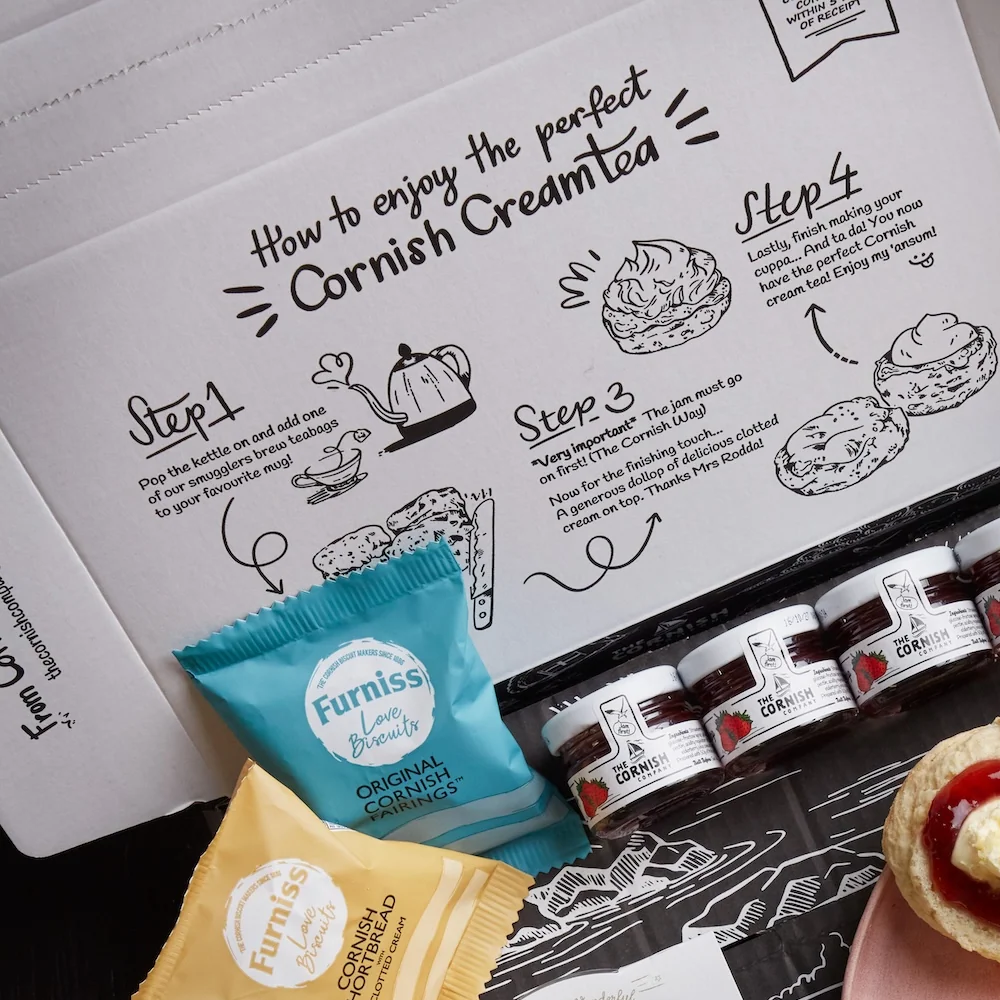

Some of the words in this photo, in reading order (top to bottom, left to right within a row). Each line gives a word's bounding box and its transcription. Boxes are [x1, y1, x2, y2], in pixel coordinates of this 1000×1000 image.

[786, 2, 825, 24] WITHIN
[800, 18, 814, 30] OF
[250, 220, 321, 268] How
[329, 195, 361, 234] to
[373, 166, 458, 220] enjoy
[465, 131, 521, 174] the
[535, 64, 652, 163] perfect
[735, 182, 821, 235] Step
[828, 151, 861, 202] 4
[747, 240, 791, 263] Lastly,
[791, 222, 828, 243] finish
[828, 204, 873, 228] making
[874, 189, 903, 212] your
[804, 235, 830, 257] And
[831, 233, 847, 243] ta
[848, 221, 867, 237] da!
[867, 211, 894, 228] You
[896, 199, 923, 217] now
[290, 219, 456, 312] Cornish
[759, 274, 791, 293] have
[791, 264, 814, 278] the
[816, 241, 863, 271] perfect
[864, 219, 916, 247] Cornish
[766, 285, 806, 308] cream
[806, 271, 832, 289] tea!
[832, 257, 870, 279] Enjoy
[871, 249, 890, 263] my
[127, 392, 209, 446] Step
[206, 381, 240, 424] 1
[514, 396, 596, 442] Step
[604, 381, 635, 414] 3
[641, 405, 670, 421] The
[669, 396, 694, 414] jam
[695, 379, 726, 400] must
[727, 374, 743, 388] go
[138, 474, 167, 491] Pop
[167, 463, 191, 477] the
[190, 446, 232, 468] kettle
[233, 439, 251, 451] on
[252, 424, 276, 443] and
[277, 413, 301, 433] add
[302, 406, 327, 422] one
[148, 489, 162, 504] of
[164, 483, 186, 498] our
[188, 455, 253, 488] smugglers
[252, 441, 287, 460] brew
[287, 419, 339, 445] teabags
[539, 473, 556, 485] on
[556, 456, 588, 477] first!
[588, 445, 620, 463] (The
[621, 421, 672, 448] Cornish
[672, 403, 707, 426] Way)
[556, 508, 569, 520] A
[570, 485, 626, 517] generous
[628, 468, 664, 489] dollop
[667, 457, 679, 471] of
[682, 437, 734, 465] delicious
[736, 413, 780, 441] clotted
[155, 508, 171, 518] to
[172, 494, 201, 515] your
[203, 470, 262, 499] favourite
[263, 453, 293, 474] mug!
[548, 488, 580, 507] Now
[581, 478, 601, 492] for
[602, 469, 625, 482] the
[625, 446, 677, 473] finishing
[563, 512, 602, 533] cream
[602, 504, 619, 516] on
[618, 495, 644, 508] top.
[643, 472, 692, 496] Thanks
[692, 460, 720, 477] Mrs
[720, 438, 764, 464] Rodda!
[893, 634, 910, 646] THE
[896, 628, 950, 658] CORNISH
[19, 685, 58, 740] From
[312, 668, 423, 726] Furniss
[360, 707, 402, 736] Love
[757, 694, 774, 706] THE
[760, 687, 814, 718] CORNISH
[348, 714, 419, 759] Biscuits
[356, 756, 443, 799] ORIGINAL
[364, 767, 450, 814] CORNISH
[612, 761, 629, 774] THE
[616, 752, 670, 785] CORNISH
[248, 865, 309, 976] Furniss
[287, 907, 316, 950] Love
[296, 900, 336, 975] Biscuits
[337, 907, 378, 990] CORNISH
[389, 916, 406, 954] CREAM
[376, 950, 385, 965] WITH
